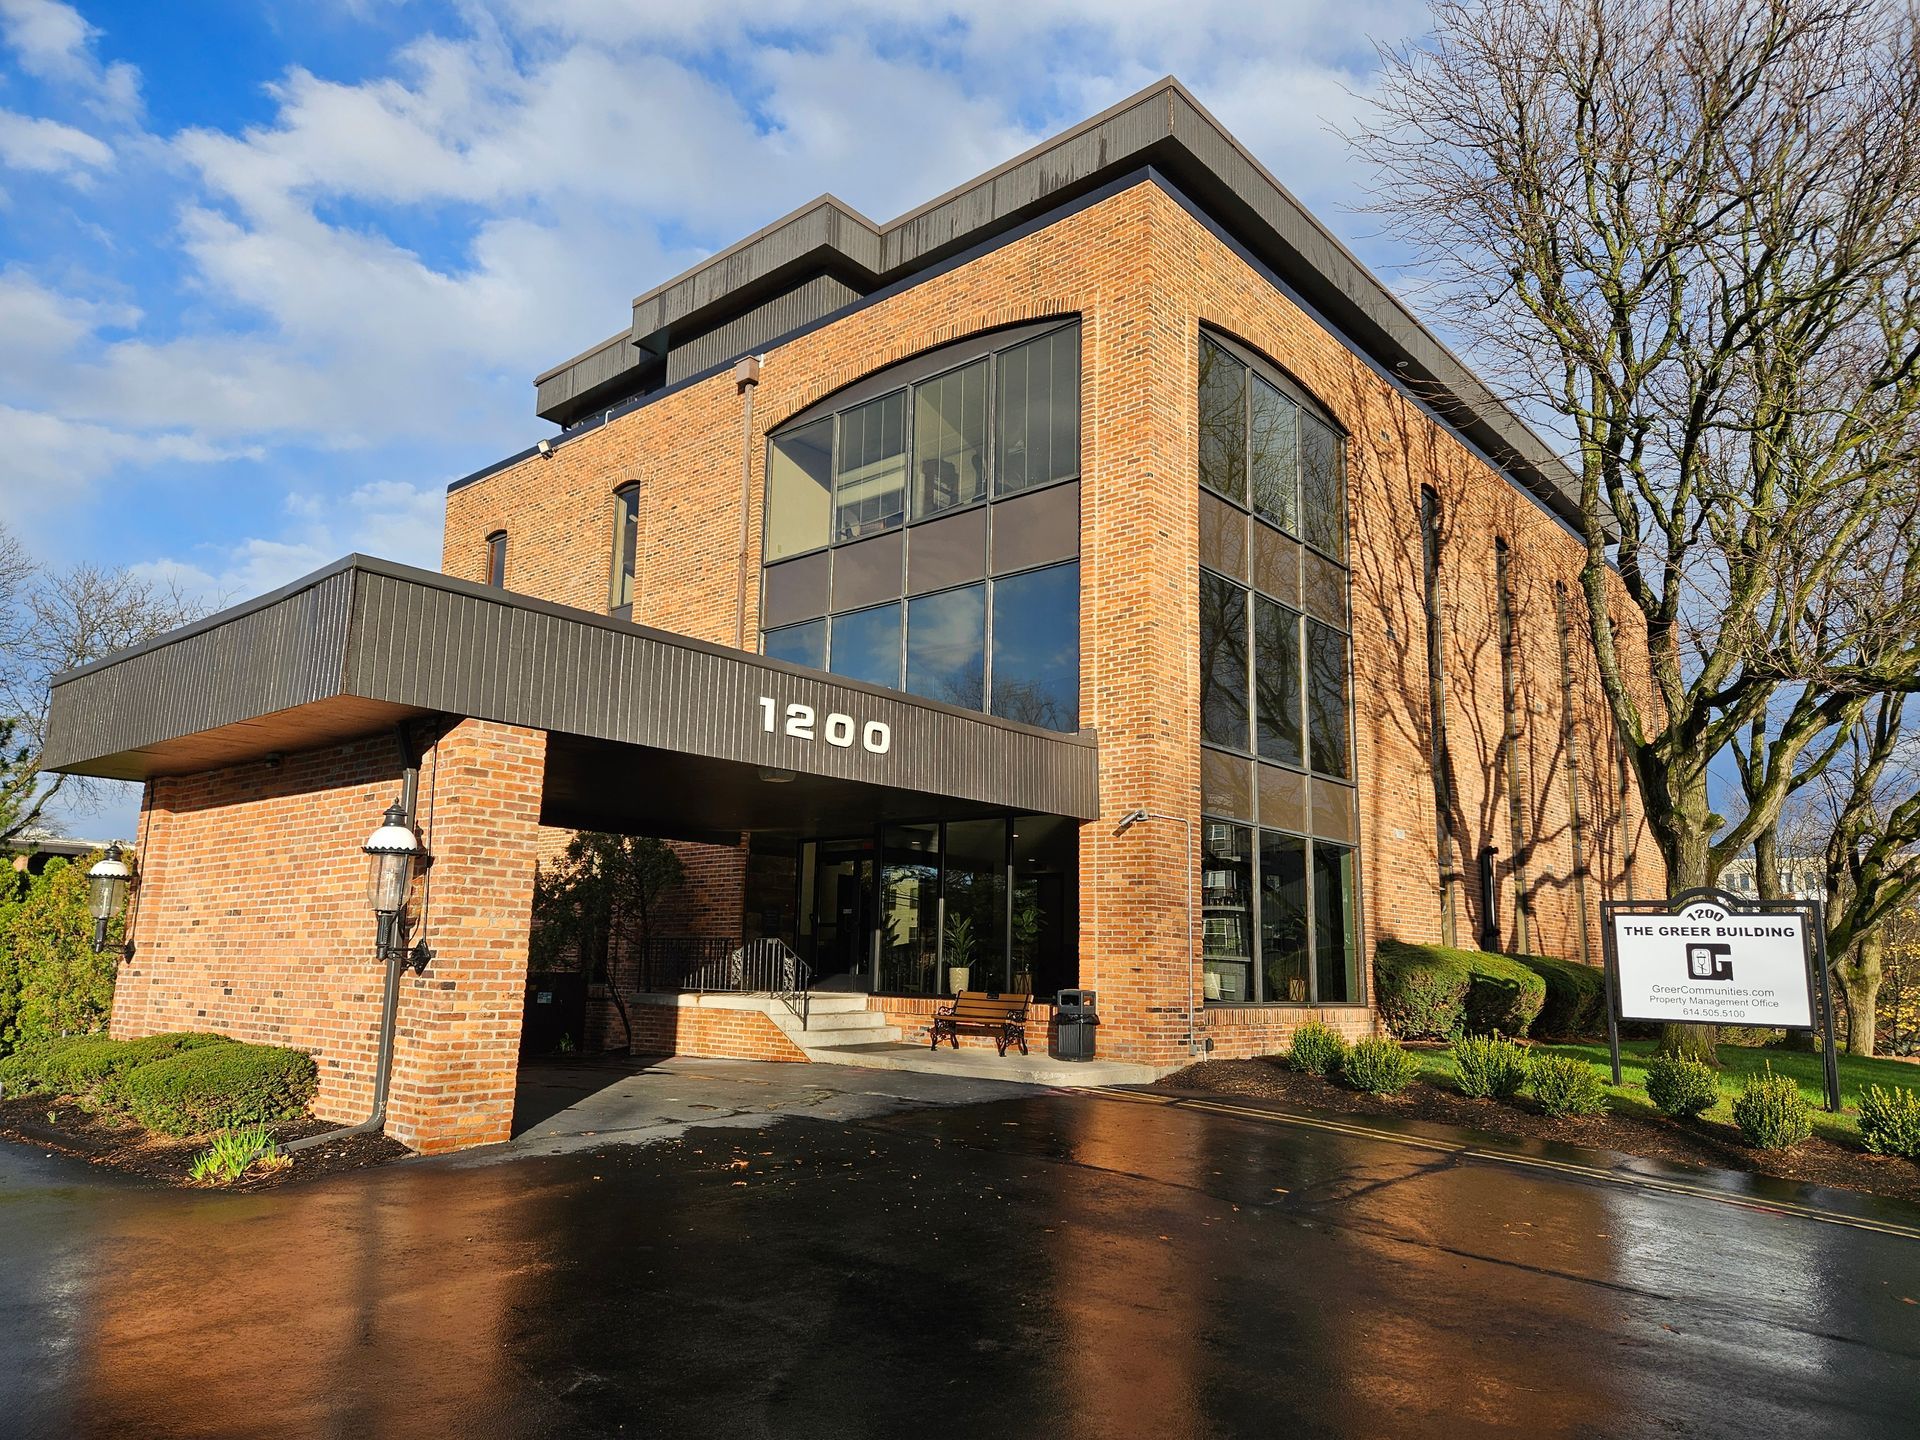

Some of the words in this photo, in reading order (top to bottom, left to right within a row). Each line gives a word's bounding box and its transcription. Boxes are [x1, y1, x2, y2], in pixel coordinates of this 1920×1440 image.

[759, 696, 891, 754] 1200
[1687, 909, 1724, 922] 1200
[1624, 927, 1653, 936] THE
[1659, 927, 1711, 937] GREER
[1717, 927, 1794, 937] BUILDING
[1652, 985, 1775, 997] GreerCommunities.com
[1649, 996, 1687, 1005] Property
[1689, 997, 1749, 1008] Management
[1751, 999, 1779, 1008] Office
[1683, 1008, 1745, 1018] 614.505.5100
